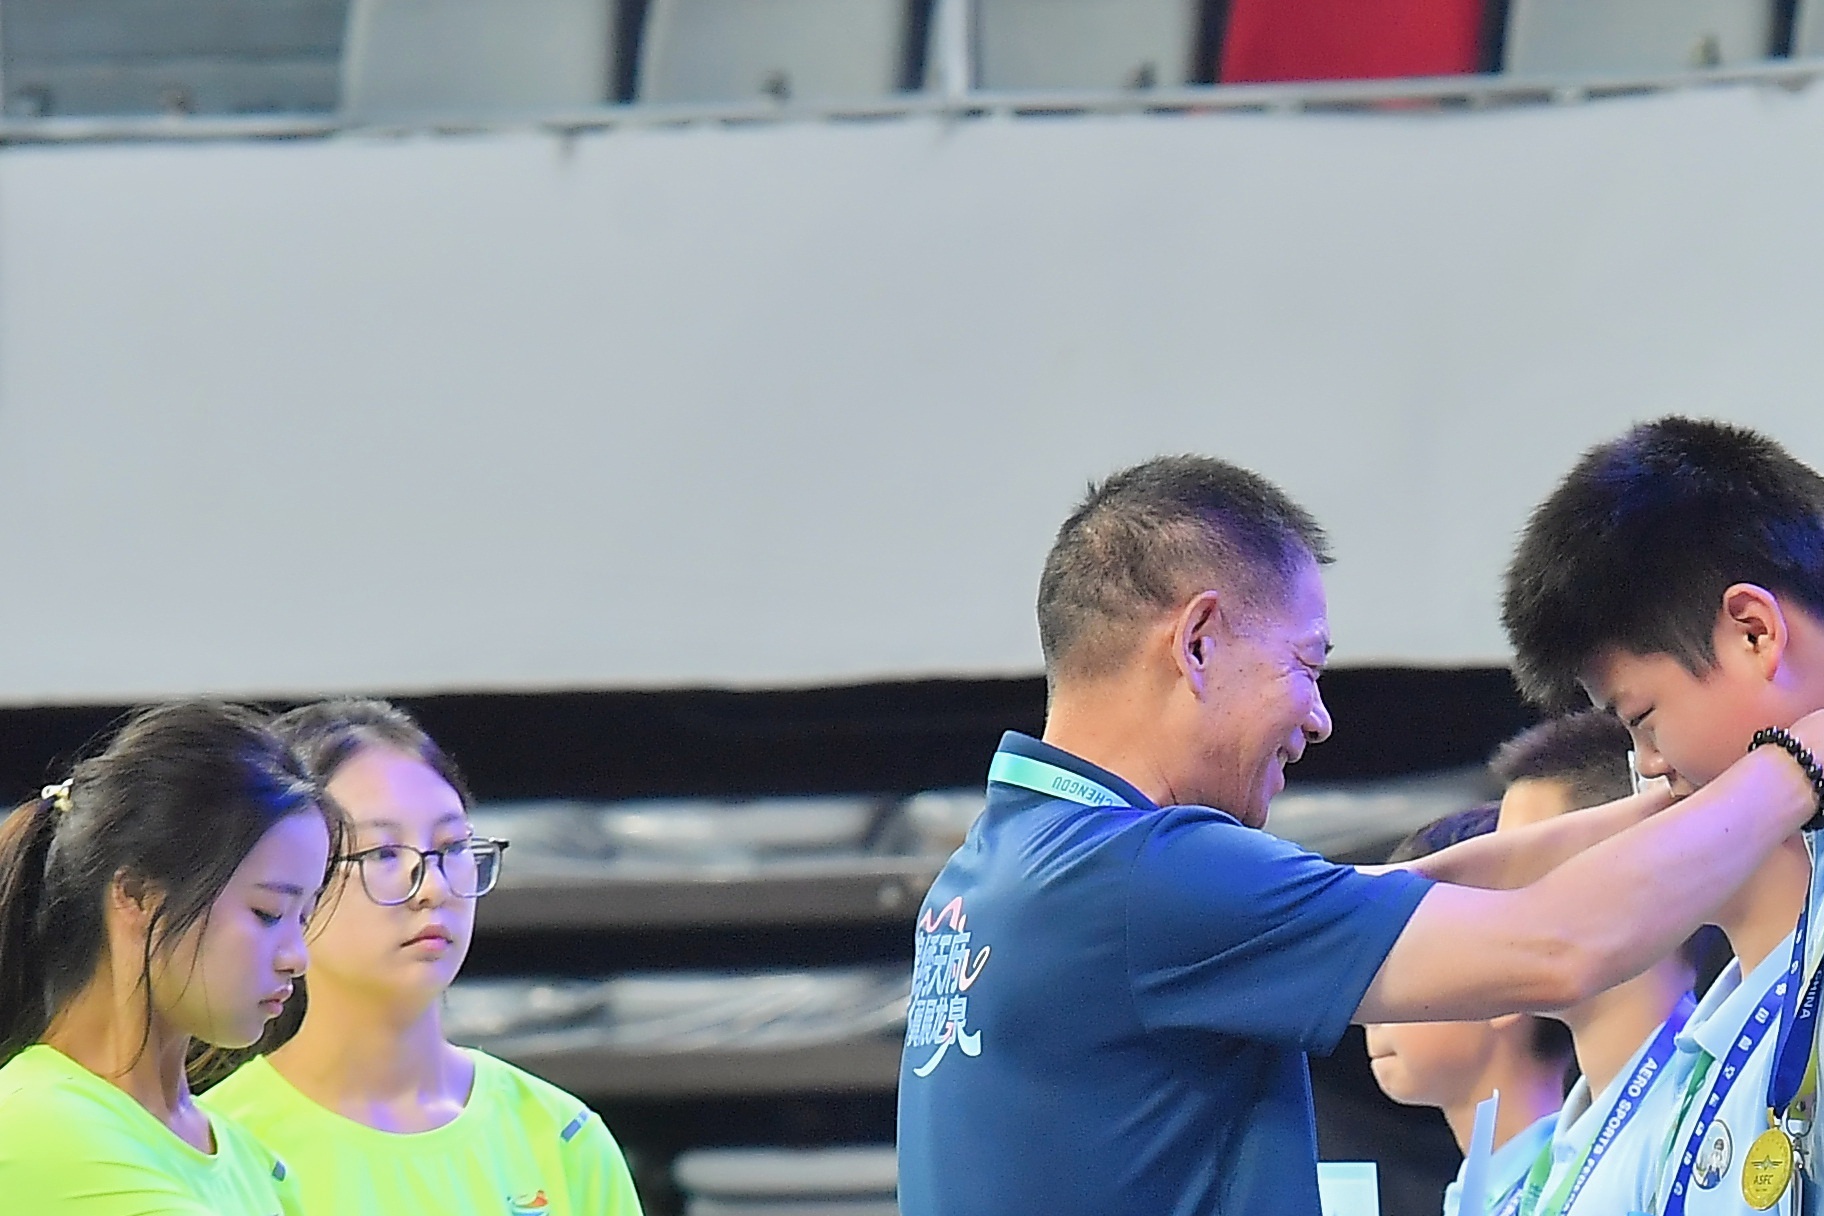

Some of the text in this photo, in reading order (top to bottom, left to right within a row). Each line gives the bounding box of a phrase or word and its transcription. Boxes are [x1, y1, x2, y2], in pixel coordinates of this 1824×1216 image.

[1051, 776, 1113, 807] CHENGDU
[1628, 1057, 1658, 1098] AERO
[1593, 1099, 1632, 1155] SPORTS
